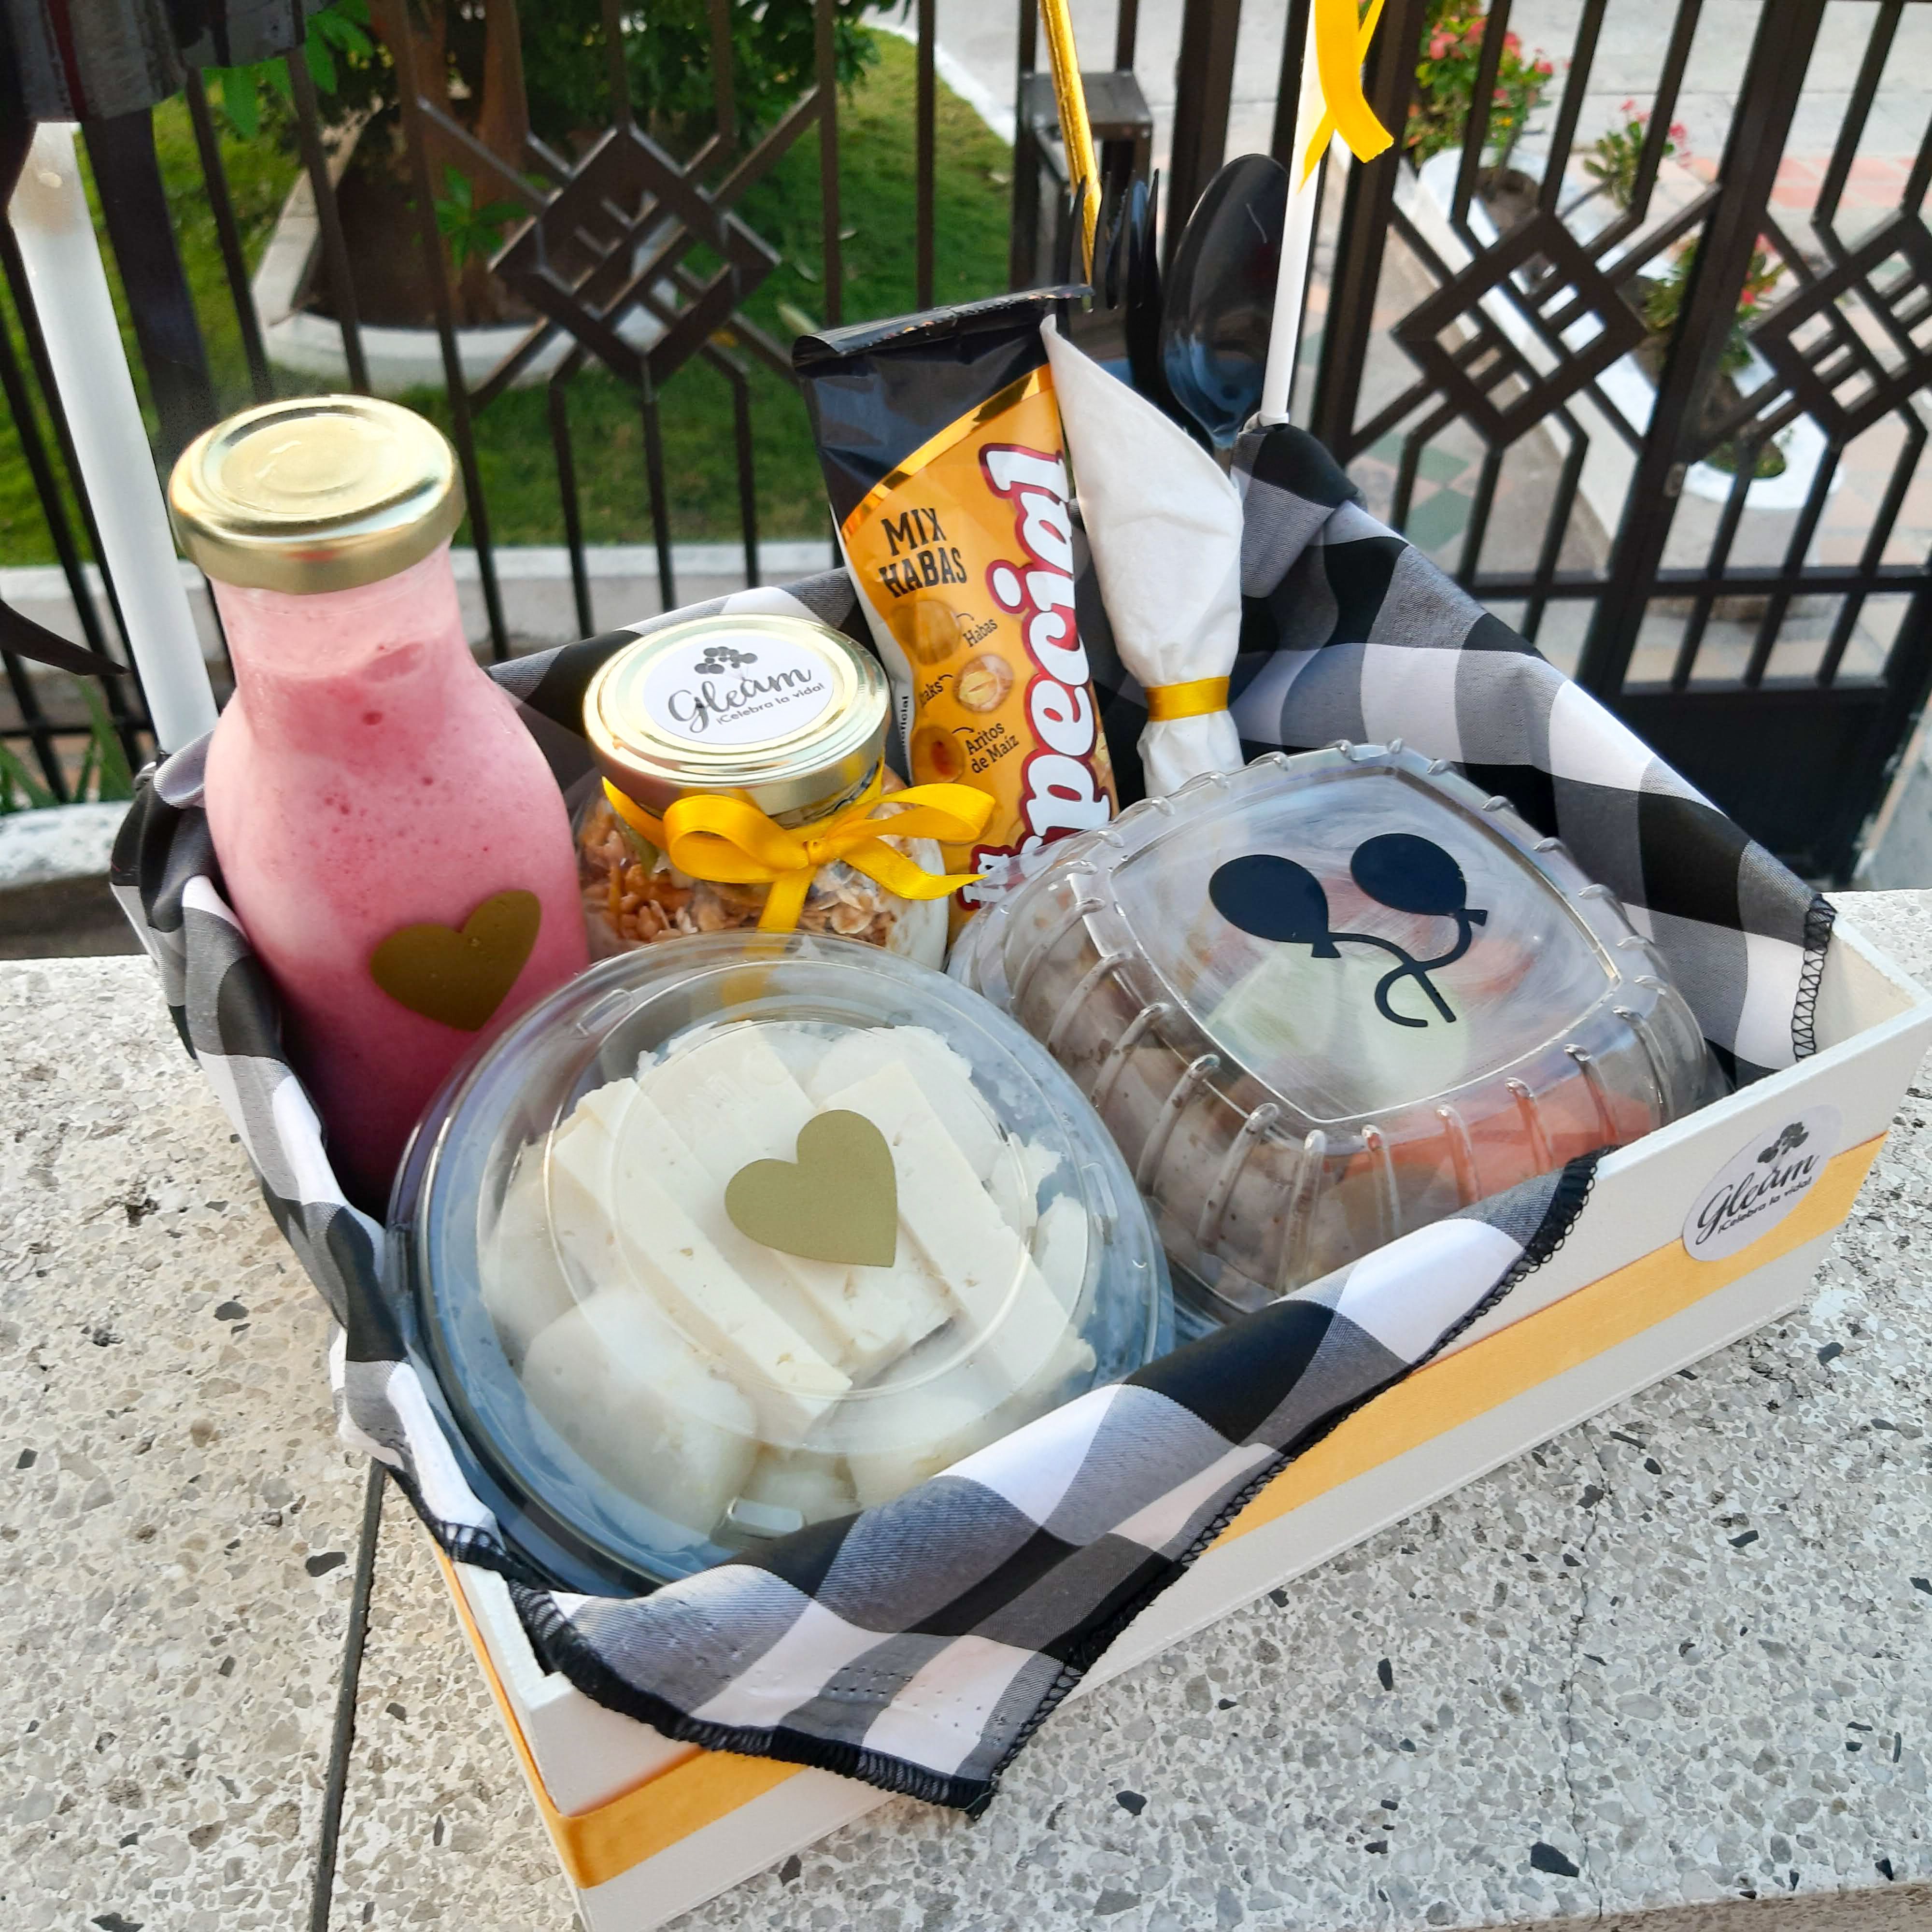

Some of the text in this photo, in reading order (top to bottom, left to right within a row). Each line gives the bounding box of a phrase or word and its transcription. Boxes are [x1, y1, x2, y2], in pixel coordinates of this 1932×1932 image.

[881, 508, 947, 556] MIX
[879, 547, 967, 598] HABAS
[963, 619, 998, 648] Habas
[980, 443, 1111, 852] pecial
[668, 669, 812, 733] Gleam
[775, 696, 790, 705] la
[918, 680, 943, 709] aks
[965, 723, 1005, 755] Aritos
[971, 757, 989, 774] de
[1695, 1154, 1820, 1245] Gleam
